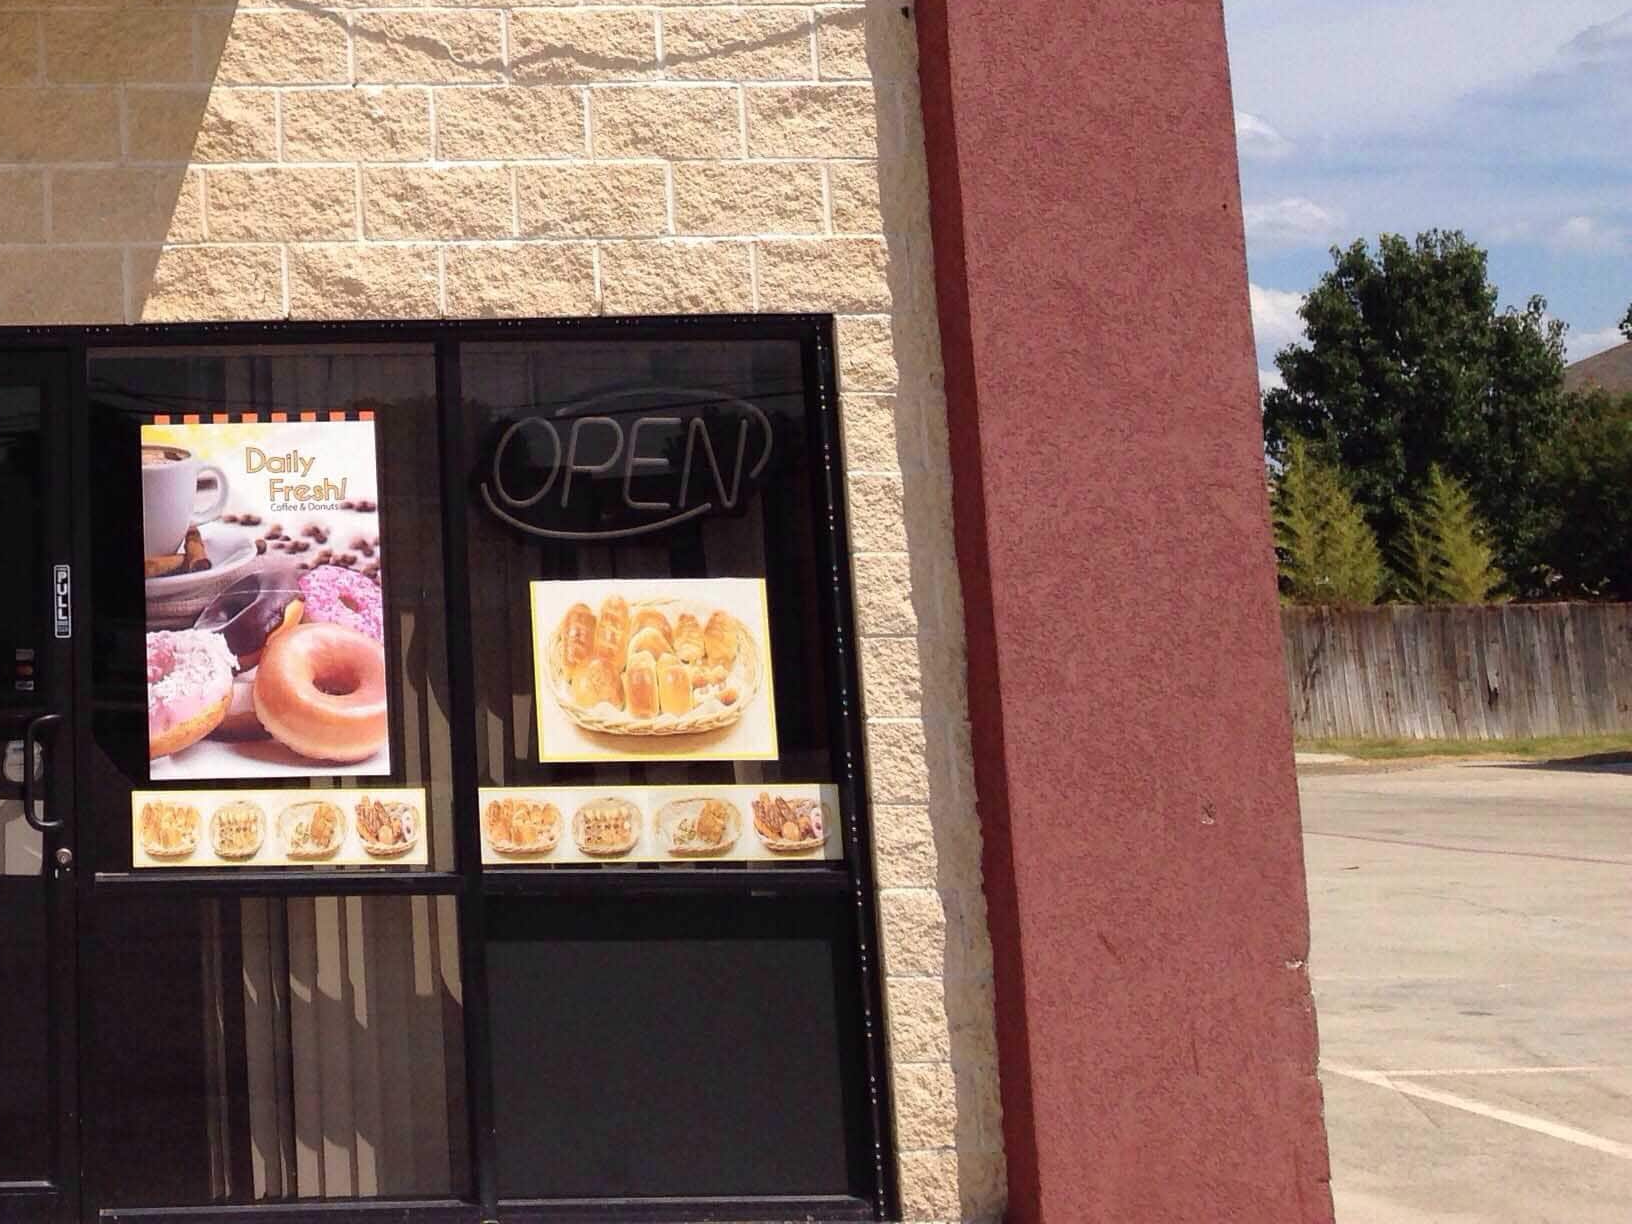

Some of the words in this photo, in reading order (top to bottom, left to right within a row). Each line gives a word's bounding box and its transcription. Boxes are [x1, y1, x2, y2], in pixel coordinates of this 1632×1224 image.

[245, 446, 316, 477] Daily
[492, 414, 751, 512] OPEN
[268, 477, 348, 502] Fresh!
[270, 503, 298, 512] Coffee
[299, 503, 306, 511] &
[307, 502, 339, 511] Donuts
[56, 571, 68, 620] PULL
